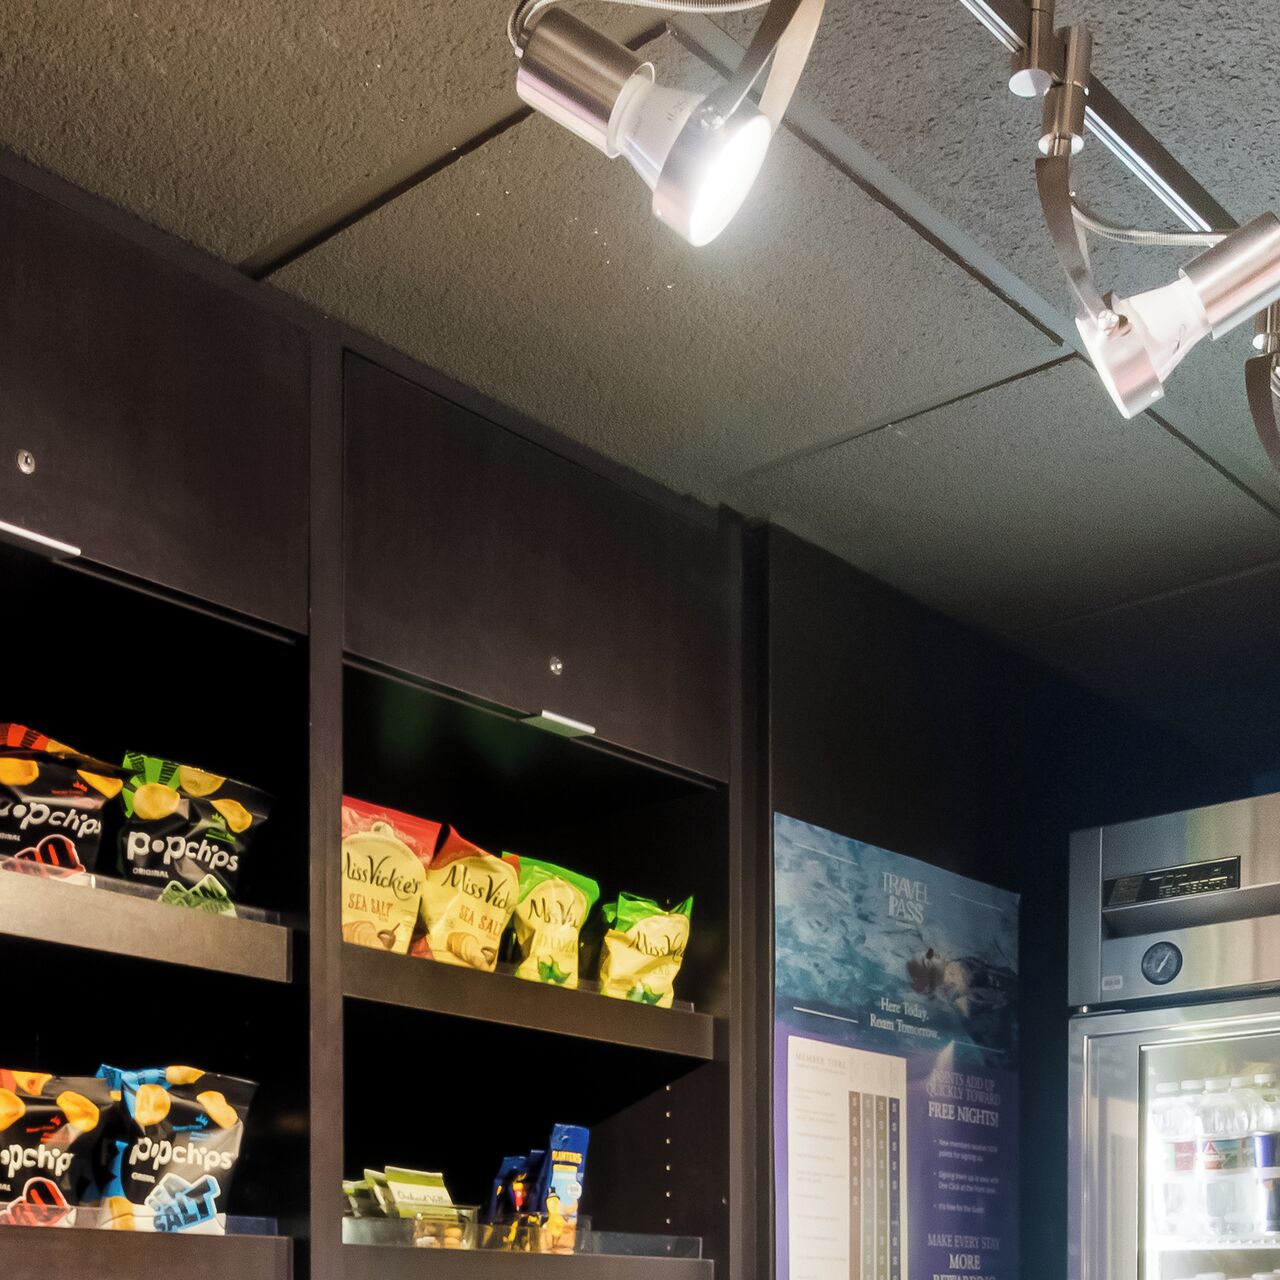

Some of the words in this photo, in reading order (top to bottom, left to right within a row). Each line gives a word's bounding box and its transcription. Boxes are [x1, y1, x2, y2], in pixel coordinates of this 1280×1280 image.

[127, 832, 239, 872] popchips
[132, 867, 169, 879] ORIGINAL
[368, 855, 422, 901] Vickie's
[441, 864, 484, 899] Miss
[881, 871, 931, 905] TRAVEL
[348, 893, 368, 911] SEA
[371, 898, 393, 917] SALT
[459, 905, 475, 926] SEA
[888, 895, 924, 924] PASS
[880, 997, 901, 1014] Here
[904, 1001, 930, 1023] Today.
[870, 1013, 895, 1031] Roam
[896, 1018, 941, 1040] Tomorrow.
[926, 1081, 964, 1100] QUICKLY
[965, 1074, 984, 1089] ADD
[928, 1101, 956, 1120] FREE
[957, 1105, 999, 1128] NIGHTS!
[129, 1137, 233, 1172] popchips
[927, 1233, 953, 1248] MAKE
[954, 1235, 980, 1249] EVERY
[981, 1236, 1001, 1250] STAY
[949, 1253, 981, 1270] MORE
